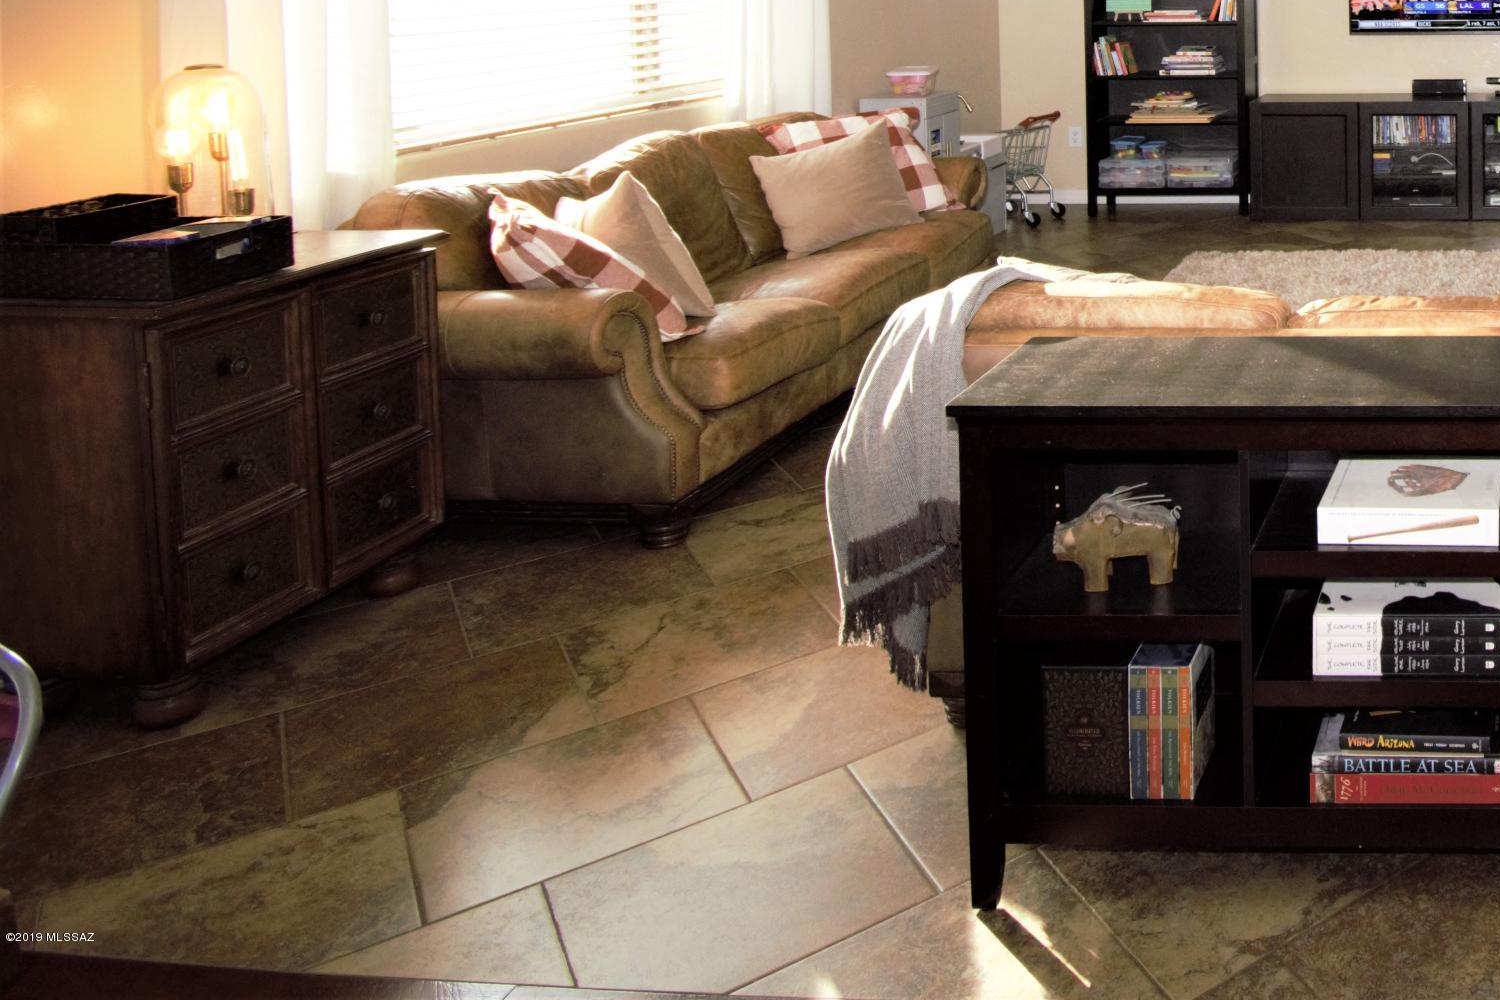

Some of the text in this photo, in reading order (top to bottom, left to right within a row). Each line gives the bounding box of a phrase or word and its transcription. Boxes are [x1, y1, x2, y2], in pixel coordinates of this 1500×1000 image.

[1347, 735, 1415, 749] WEIRD ARIZONA
[1343, 758, 1477, 773] BATTLE AT SEA
[1341, 776, 1354, 801] 1776
